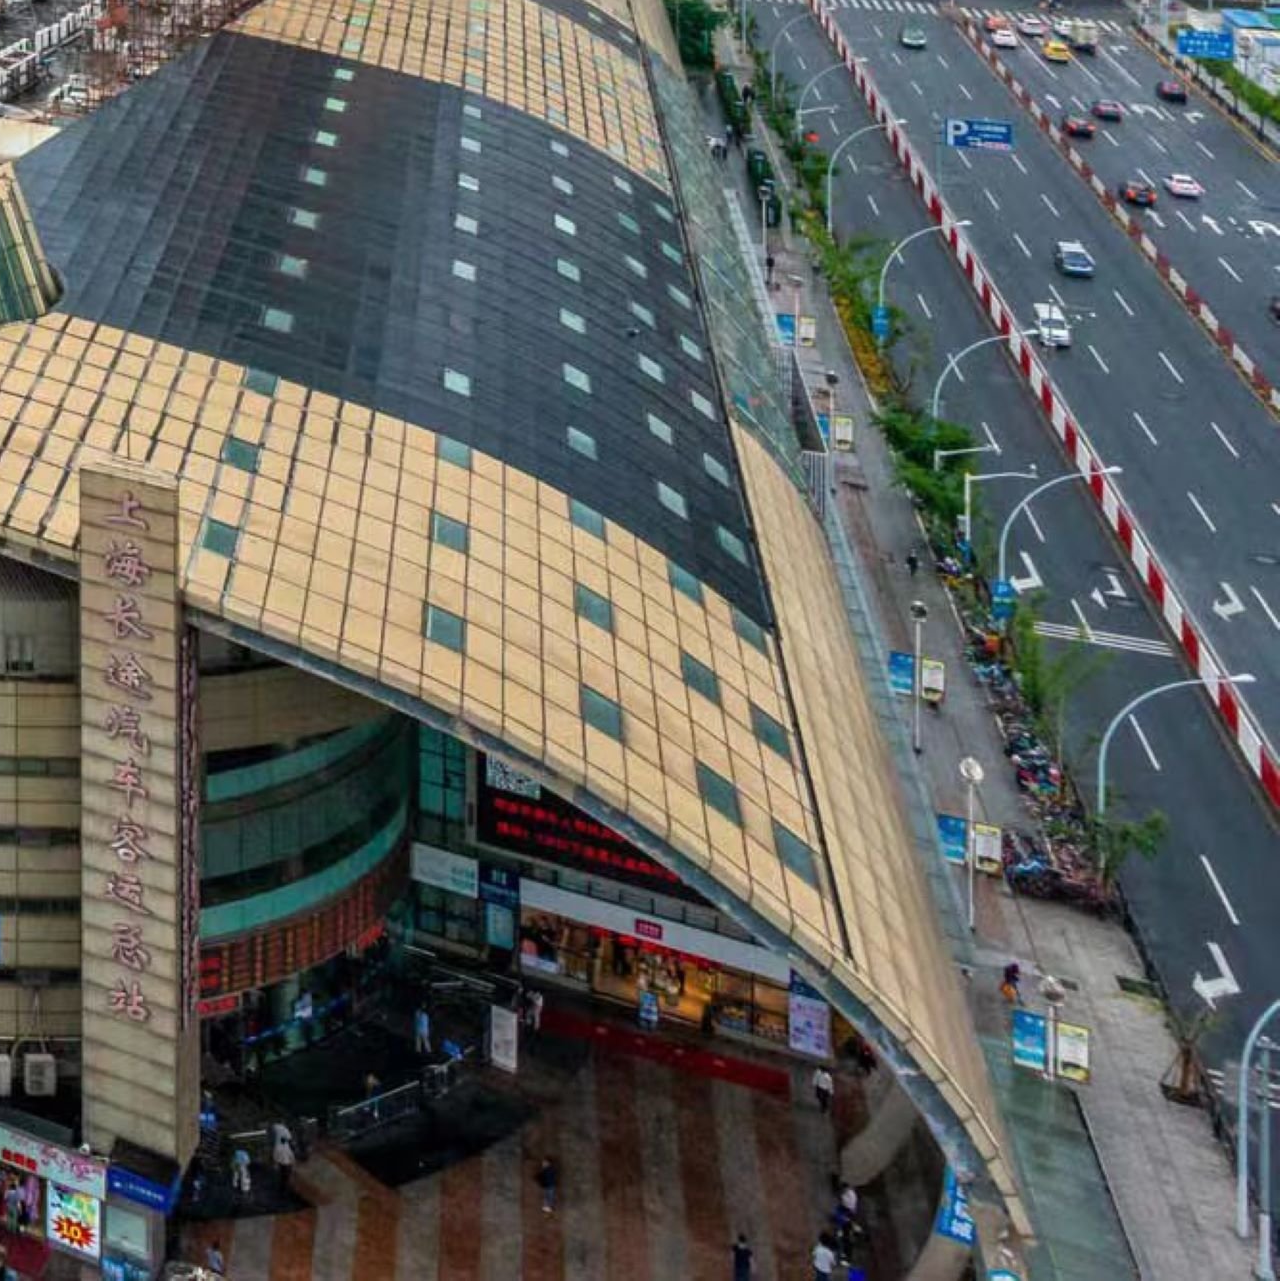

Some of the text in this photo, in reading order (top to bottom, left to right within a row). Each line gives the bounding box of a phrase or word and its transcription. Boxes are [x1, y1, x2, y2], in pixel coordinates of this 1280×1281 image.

[947, 120, 969, 146] P
[104, 491, 153, 1023] 上海长途汽车客运总站
